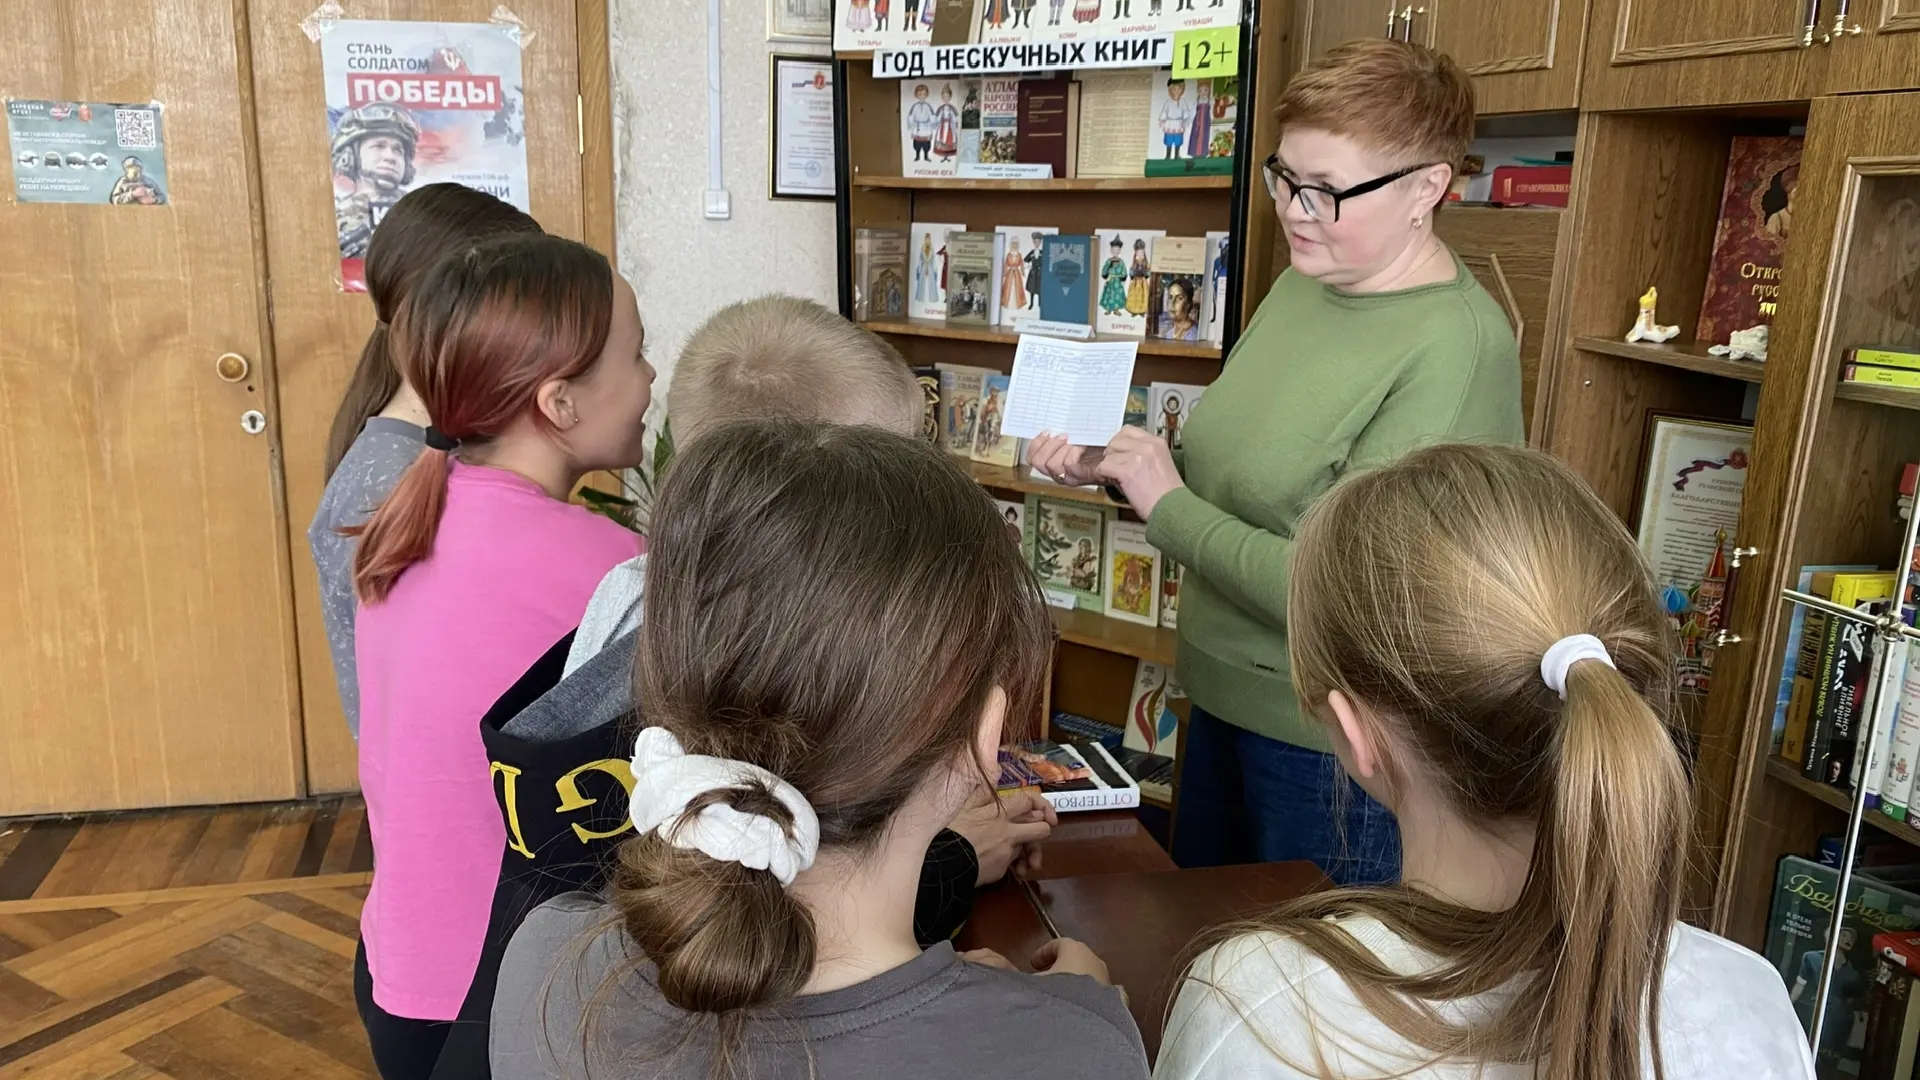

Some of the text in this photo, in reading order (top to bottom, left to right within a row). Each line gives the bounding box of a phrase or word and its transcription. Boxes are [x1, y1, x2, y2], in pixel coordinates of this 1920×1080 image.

[1120, 24, 1157, 34] МАРИЙЦЫ
[346, 43, 392, 55] СТАНЬ
[882, 38, 1167, 79] ГОД НЕСКУЧНЫХ КНИГ
[1180, 40, 1233, 71] 12+
[348, 57, 430, 71] СОЛДАТОМ
[354, 79, 496, 108] ПОБЕДЫ
[1111, 323, 1135, 331] БУРЯТЫ
[1829, 614, 1840, 644] ЖИВЦА
[1827, 643, 1836, 655] НА
[1821, 656, 1833, 691] МОЛНИЙ
[1816, 691, 1828, 717] ЛОВЛЯ
[1834, 686, 1849, 728] ВЛИЯНИЕ
[1840, 685, 1856, 737] ГИБЕЛЬНОЕ
[1110, 793, 1133, 805] ОТ
[1781, 924, 1813, 939] ДЕВУШКИ
[1786, 918, 1811, 932] ТОЛЬКО
